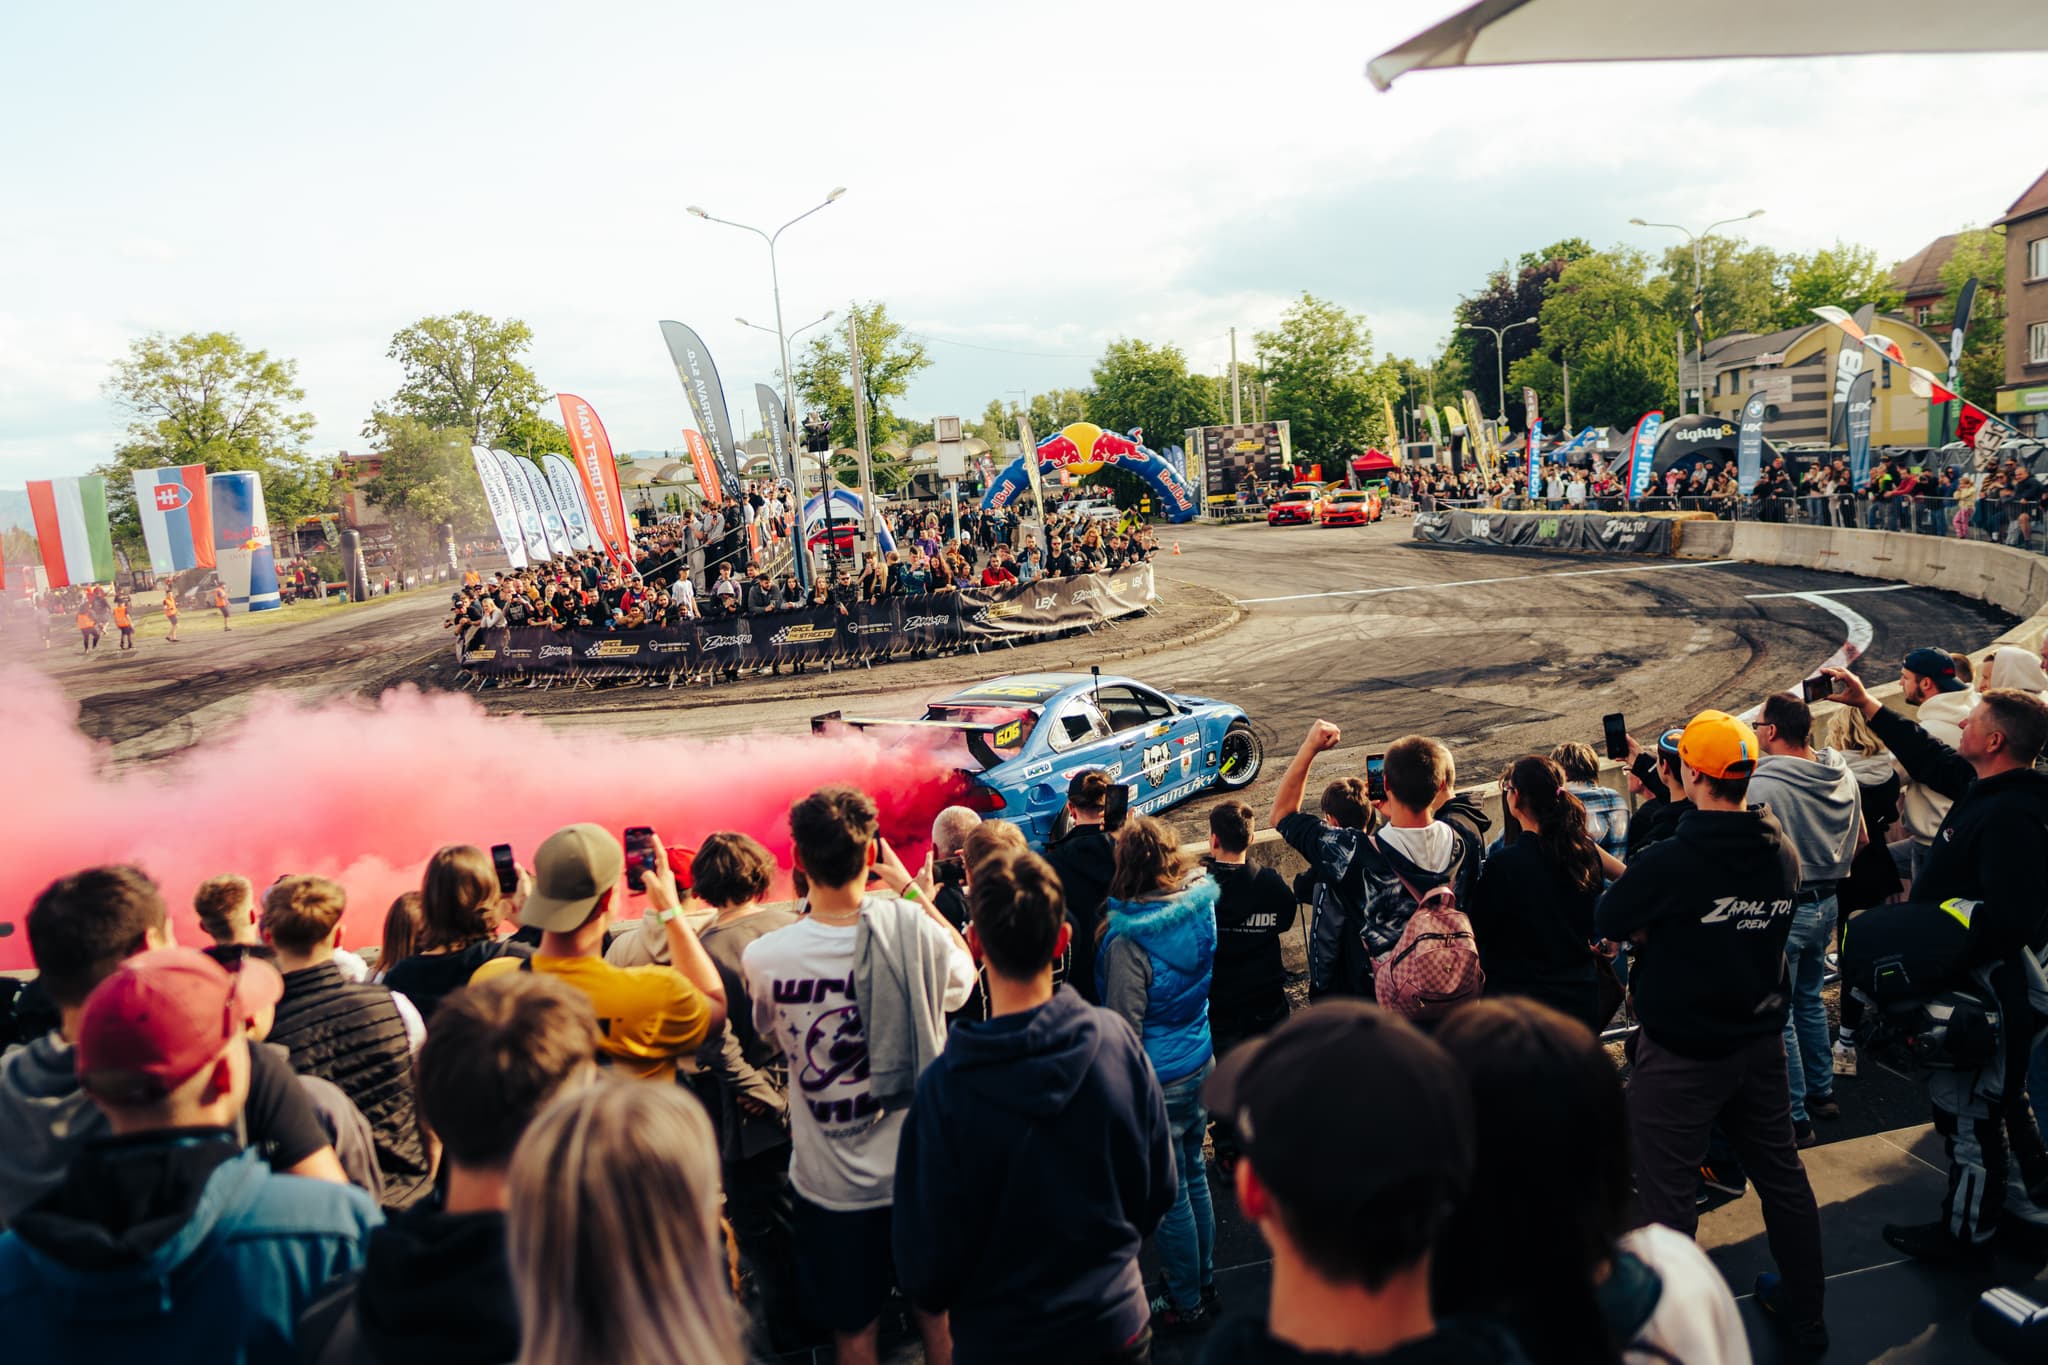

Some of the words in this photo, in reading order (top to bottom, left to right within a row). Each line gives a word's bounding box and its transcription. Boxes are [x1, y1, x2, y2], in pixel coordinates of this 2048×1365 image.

[994, 479, 1016, 504] Bull
[1157, 468, 1180, 493] Red
[1172, 486, 1193, 511] Bull
[1035, 593, 1058, 609] LEX
[1183, 732, 1200, 746] BSR
[1700, 896, 1768, 923] ZAPAL
[1770, 899, 1793, 917] TO!
[1736, 919, 1771, 930] CREW
